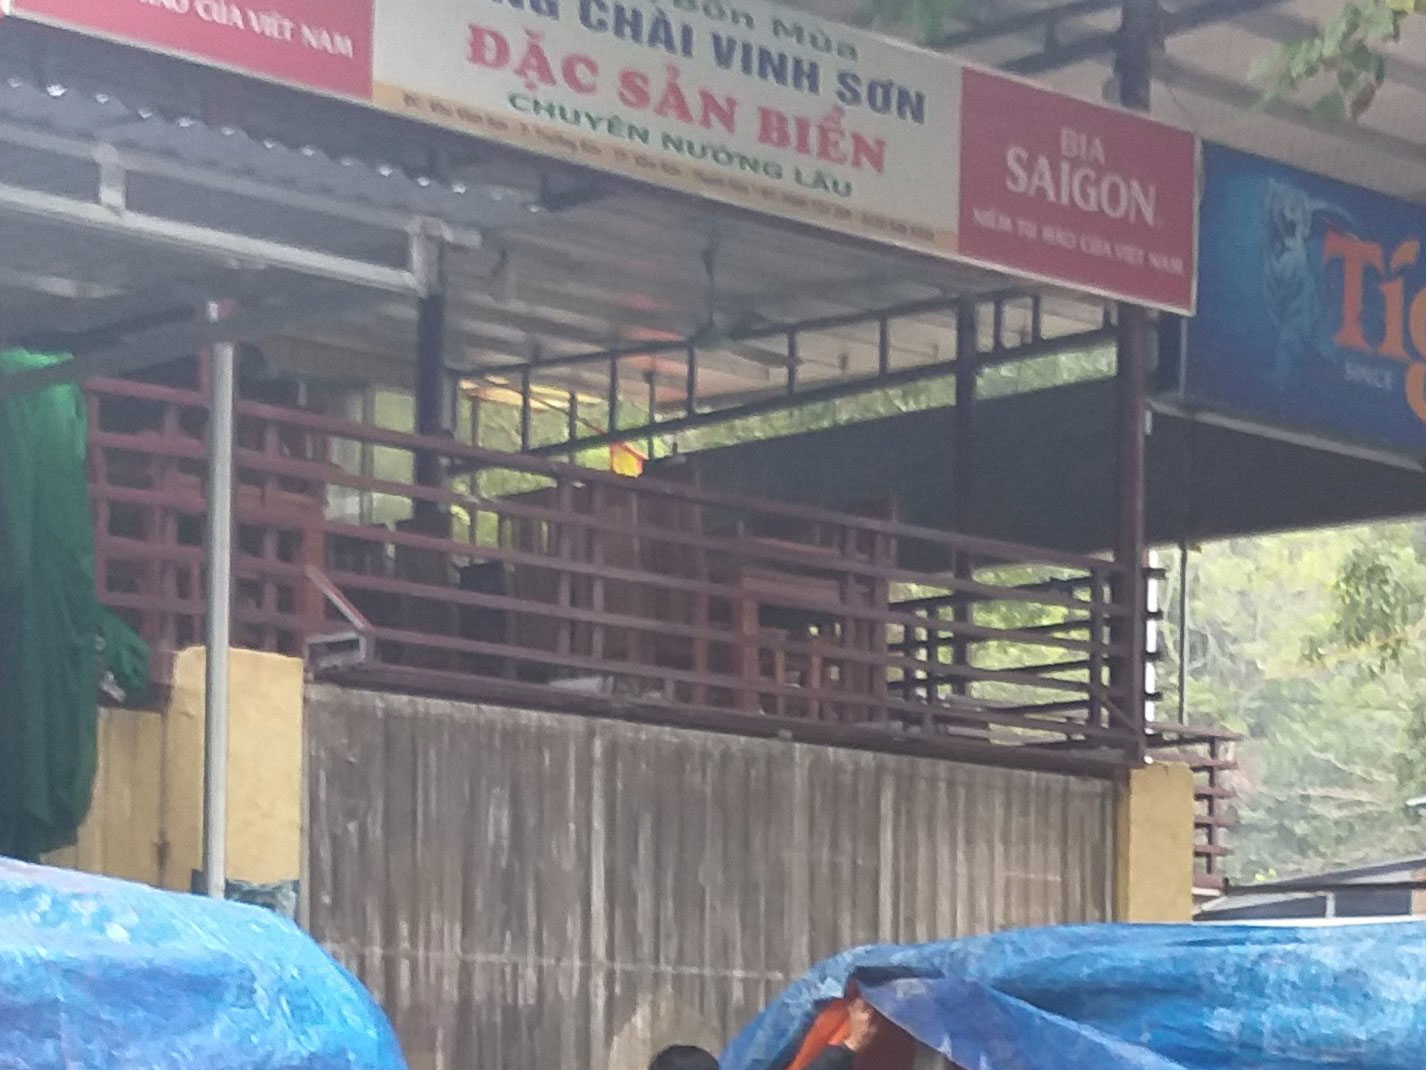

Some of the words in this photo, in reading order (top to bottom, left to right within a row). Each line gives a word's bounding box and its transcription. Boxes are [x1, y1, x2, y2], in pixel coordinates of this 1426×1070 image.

[466, 22, 600, 95] ĐẶC
[617, 63, 739, 135] SẢN
[757, 102, 888, 175] BIỂN
[506, 91, 652, 146] CHUYÊN
[711, 30, 821, 96] VINH
[834, 68, 927, 125] SƠN
[1004, 145, 1158, 227] SAIGON
[1059, 126, 1106, 165] BIA
